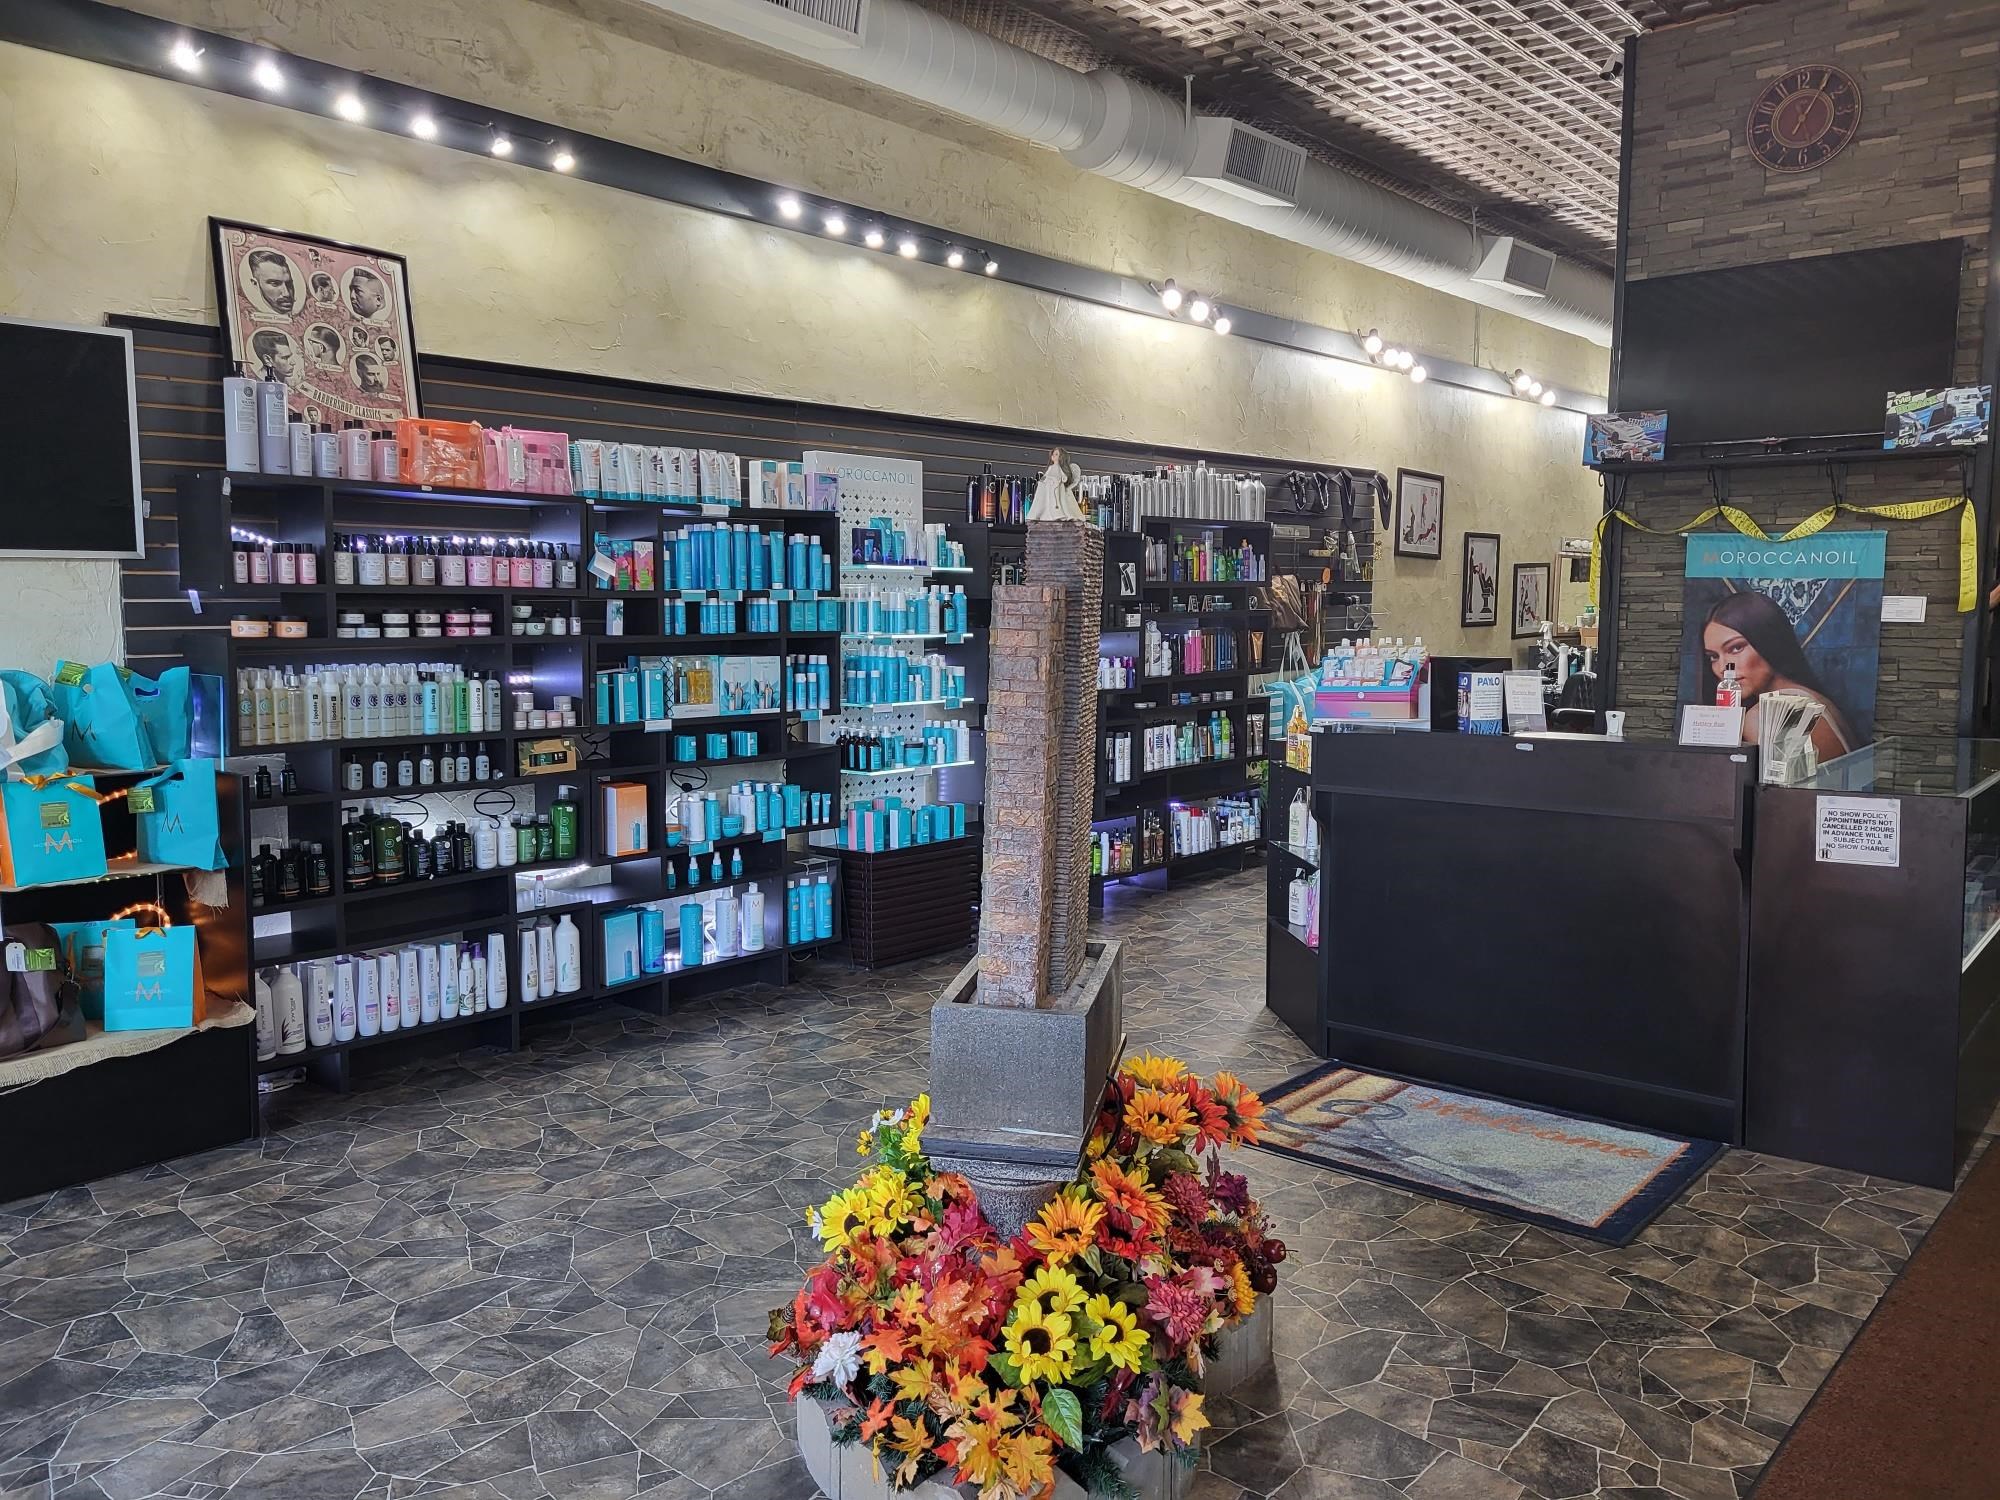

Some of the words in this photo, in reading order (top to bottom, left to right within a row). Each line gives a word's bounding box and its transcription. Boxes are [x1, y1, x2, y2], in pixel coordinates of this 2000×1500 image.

[1797, 71, 1810, 89] 12
[1775, 83, 1790, 98] 11
[1759, 101, 1777, 115] 10
[1798, 148, 1808, 165] 6
[312, 389, 353, 414] BARBERSHOP
[355, 405, 382, 420] CLASSICS
[825, 466, 915, 485] MOROCCANOIL
[1702, 551, 1858, 565] MOROCCANOIL
[1477, 676, 1501, 687] PAYLO
[161, 809, 184, 834] M
[1821, 823, 1863, 832] CANCELLED
[1823, 816, 1877, 826] APPOINTMENTS
[1831, 830, 1864, 838] ADVANCE
[1833, 836, 1864, 844] SUBJECT
[1860, 844, 1890, 853] CHARGE
[751, 900, 760, 908] M
[1407, 1094, 1659, 1160] Welcome
